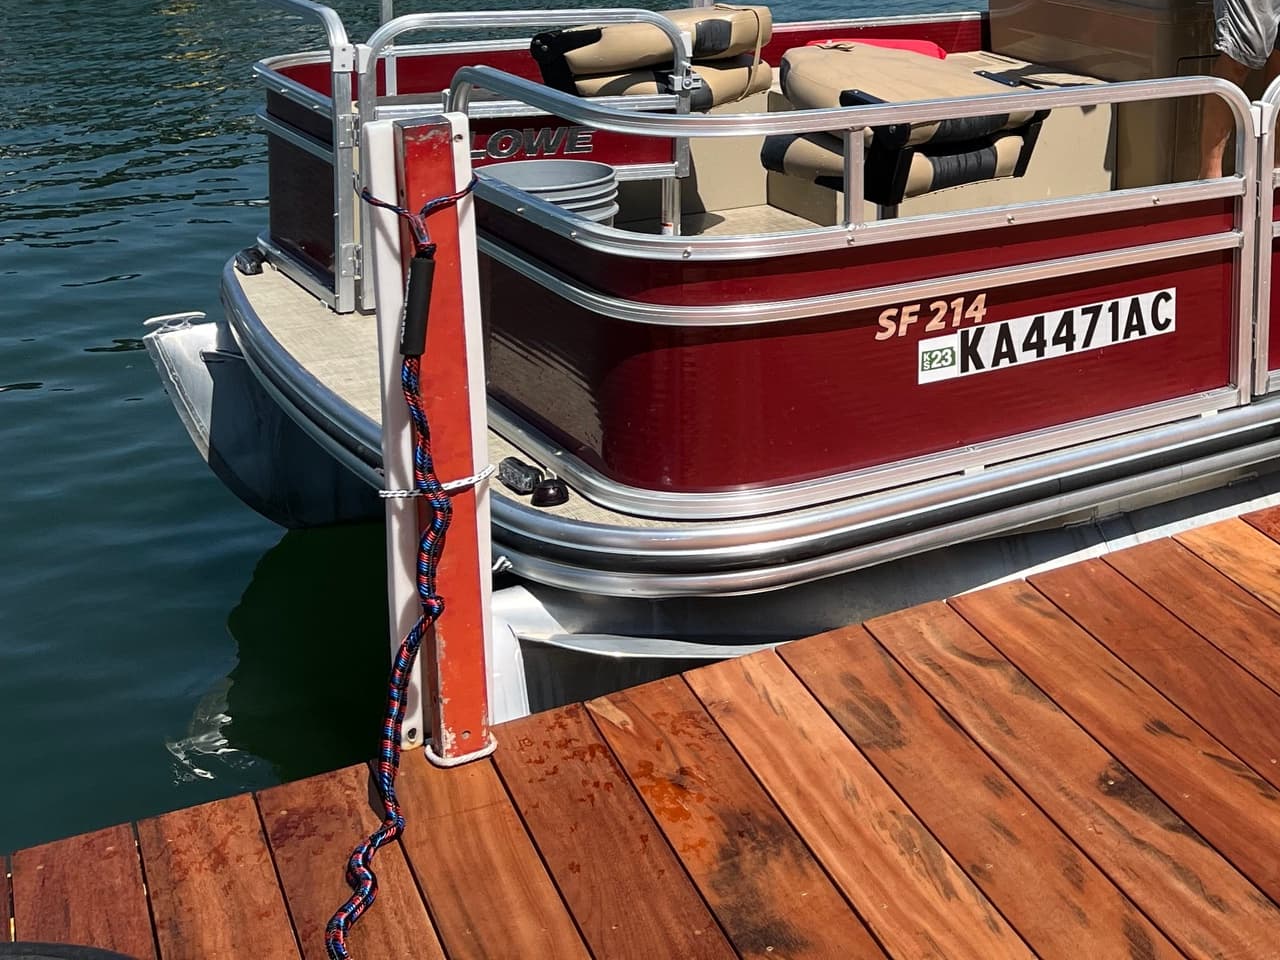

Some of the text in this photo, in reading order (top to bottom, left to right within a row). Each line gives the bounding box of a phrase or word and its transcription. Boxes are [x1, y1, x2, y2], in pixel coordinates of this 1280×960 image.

[874, 293, 987, 341] SF 214
[931, 349, 953, 369] 23
